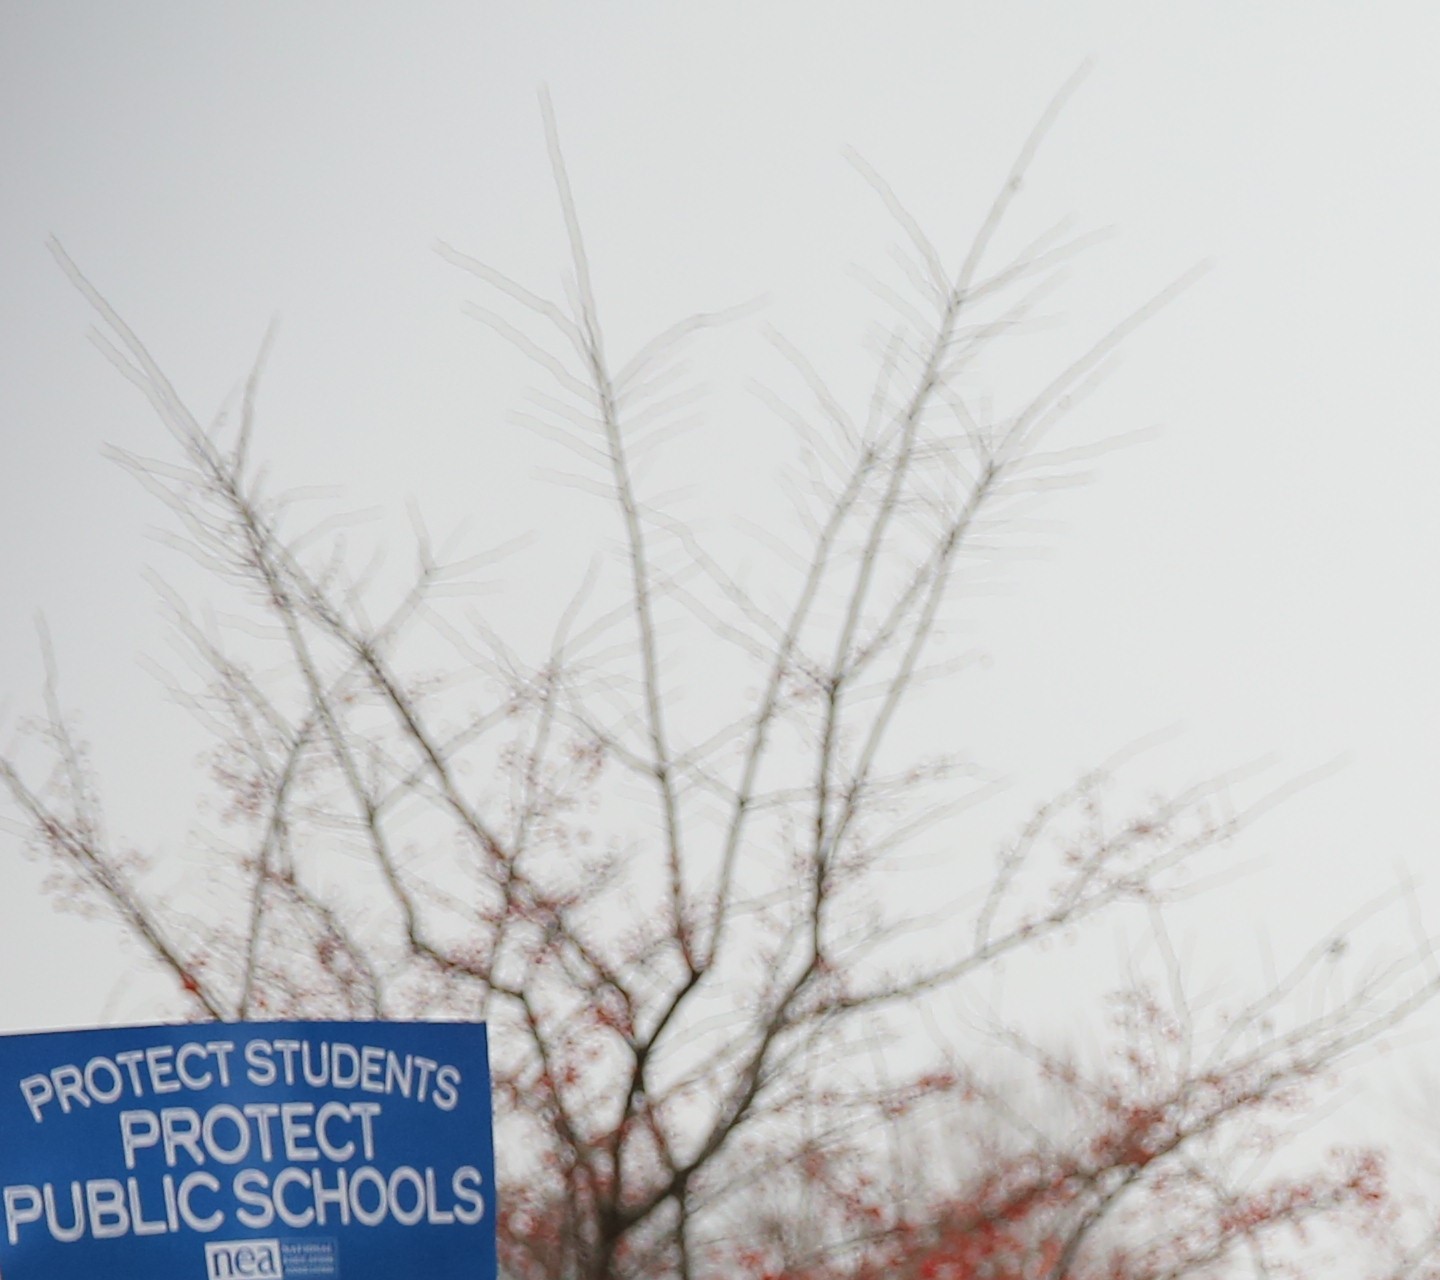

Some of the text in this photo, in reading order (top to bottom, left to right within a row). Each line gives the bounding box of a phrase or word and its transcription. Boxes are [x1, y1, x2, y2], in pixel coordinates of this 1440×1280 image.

[20, 1039, 462, 1123] PROTECT STUDENTS
[119, 1102, 381, 1170] PROTECT
[3, 1166, 486, 1246] PUBLIC SCHOOLS
[211, 1246, 278, 1279] nea
